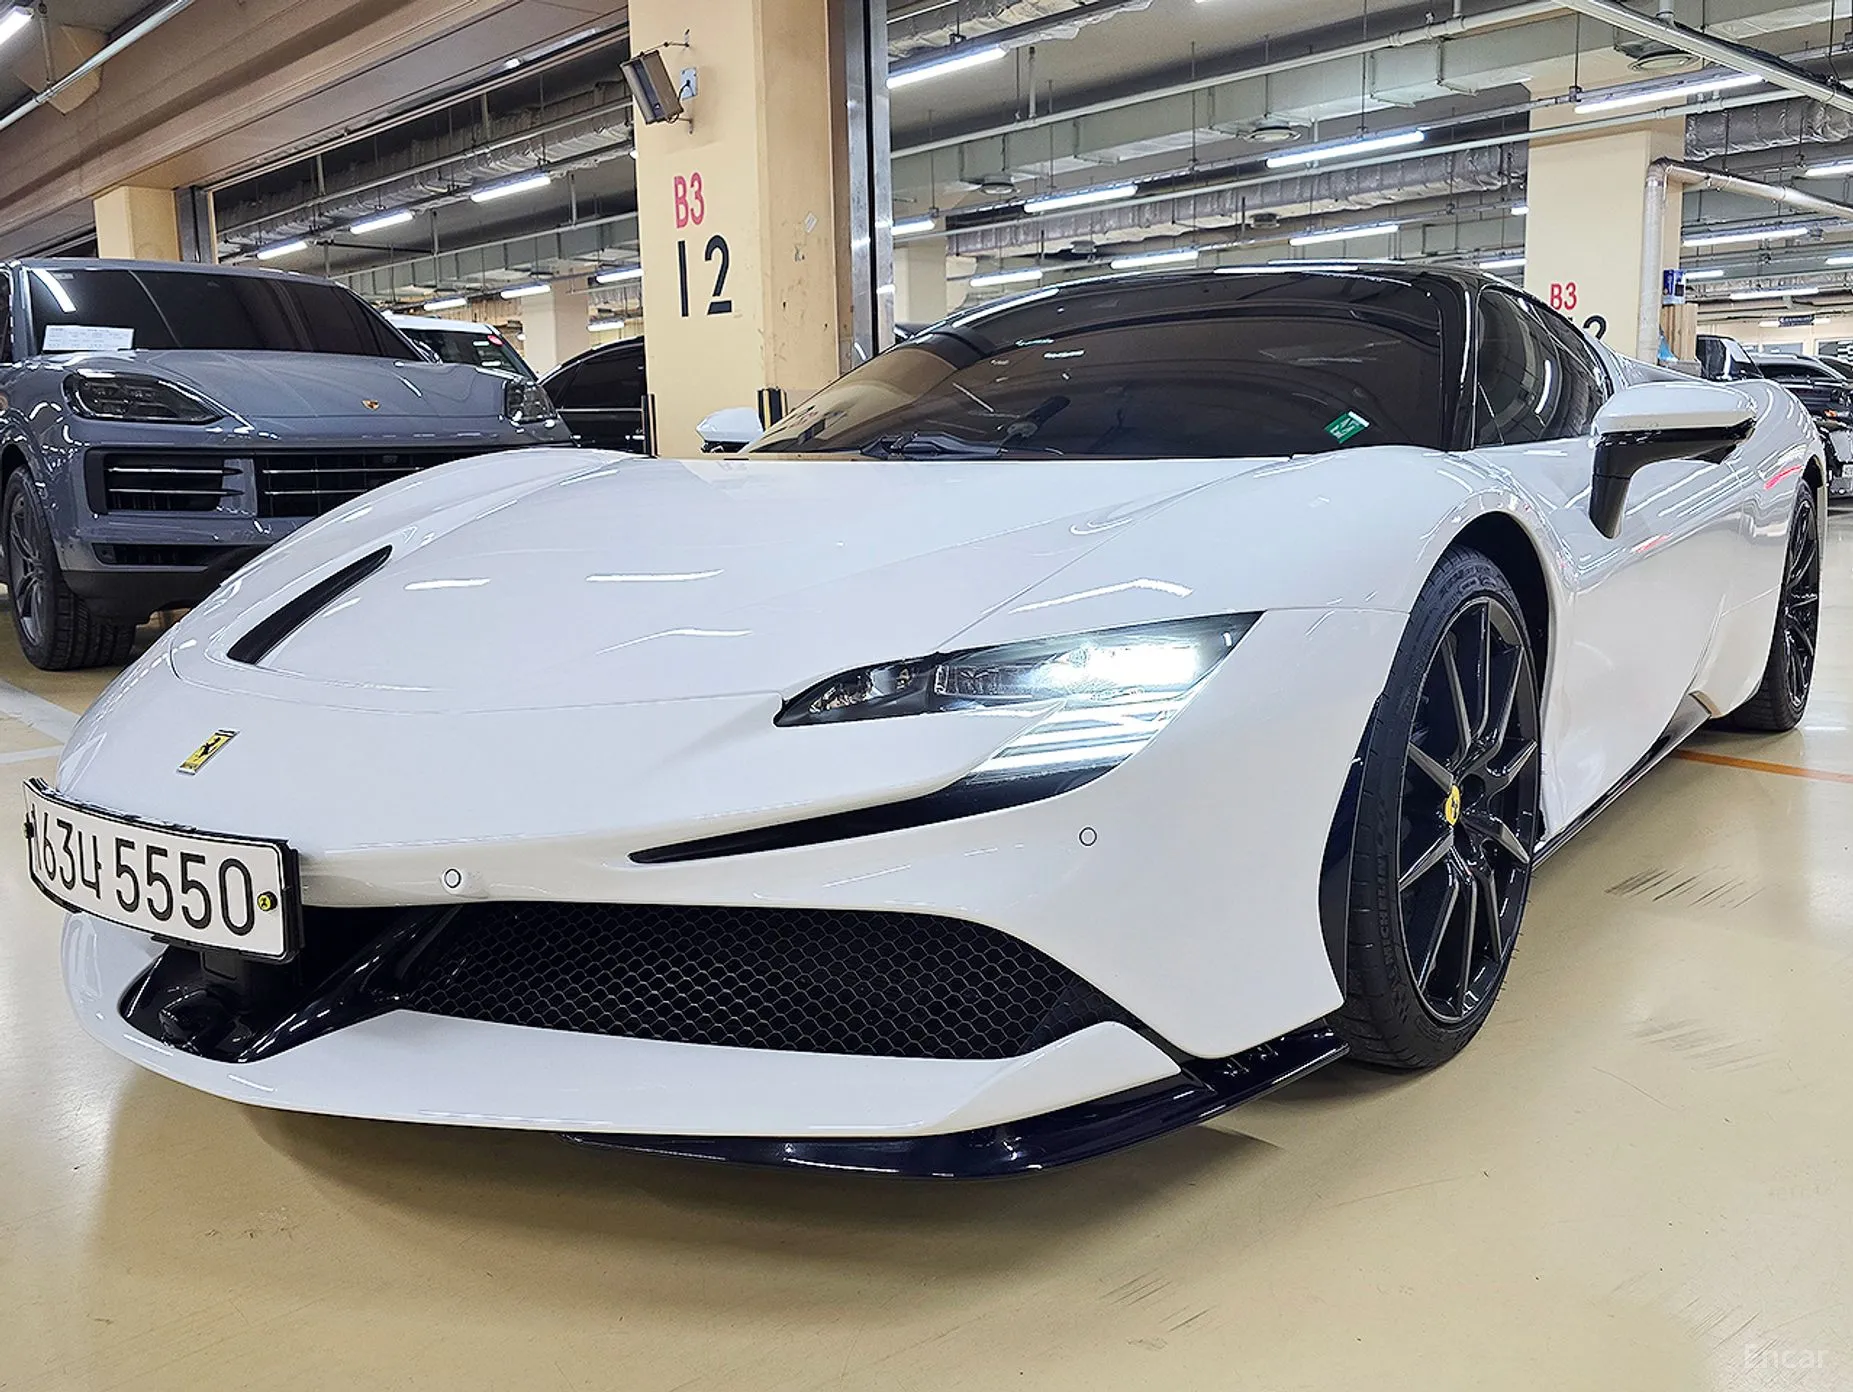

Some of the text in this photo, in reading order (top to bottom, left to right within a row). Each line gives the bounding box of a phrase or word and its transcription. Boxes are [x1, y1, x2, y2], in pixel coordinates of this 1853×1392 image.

[674, 172, 704, 228] B3
[678, 235, 732, 317] 12
[1550, 282, 1577, 310] B3
[115, 837, 255, 937] 5550
